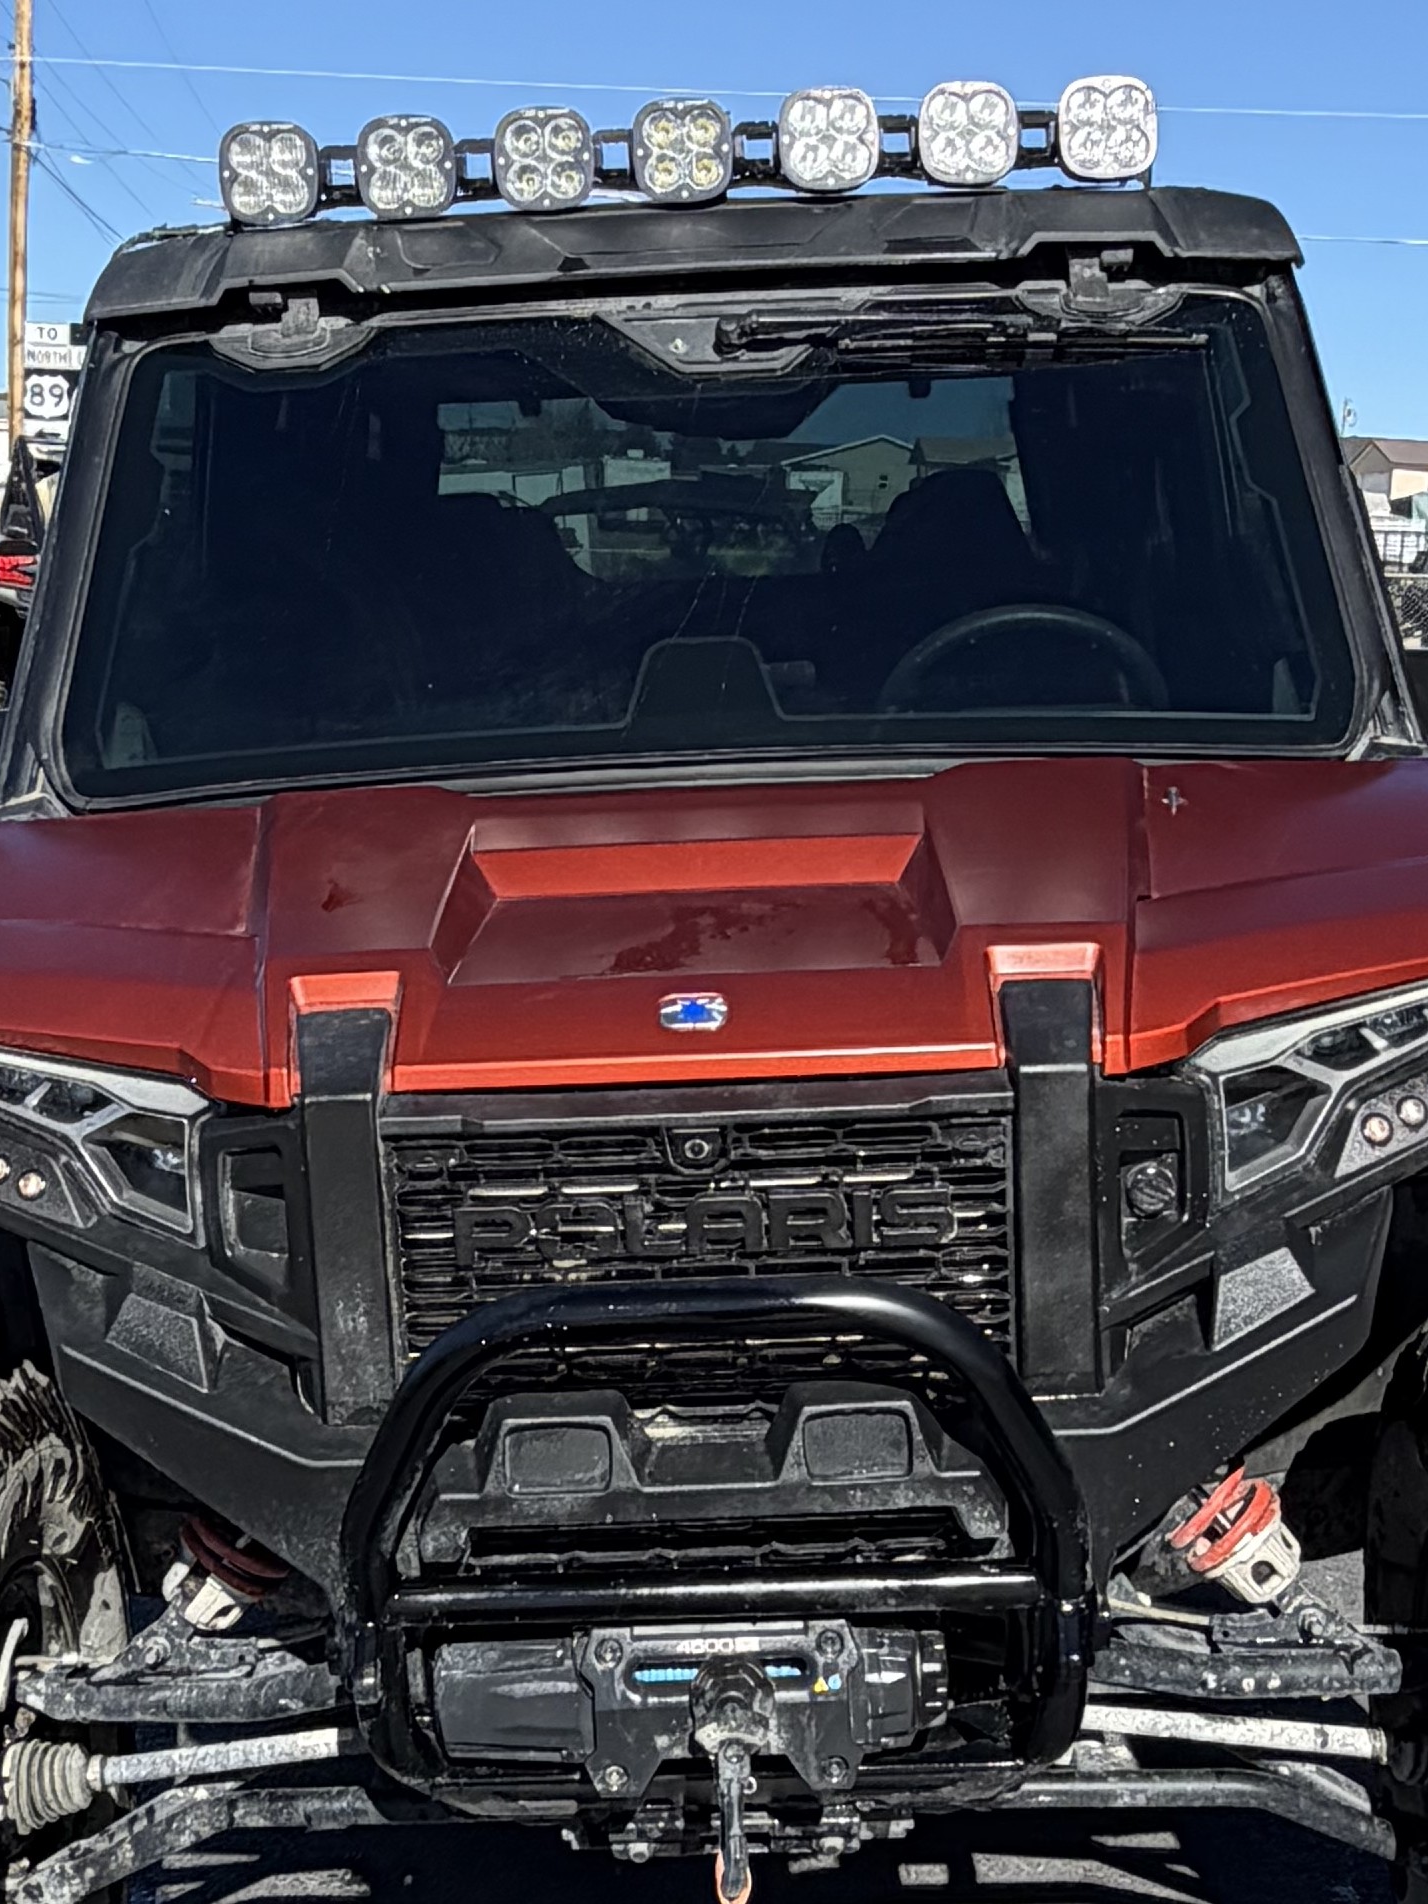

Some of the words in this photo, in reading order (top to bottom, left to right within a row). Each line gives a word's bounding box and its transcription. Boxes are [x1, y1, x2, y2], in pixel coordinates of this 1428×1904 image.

[37, 327, 58, 341] TO
[27, 349, 68, 365] NORTH
[30, 383, 64, 408] 89
[453, 1184, 957, 1267] POLARIS
